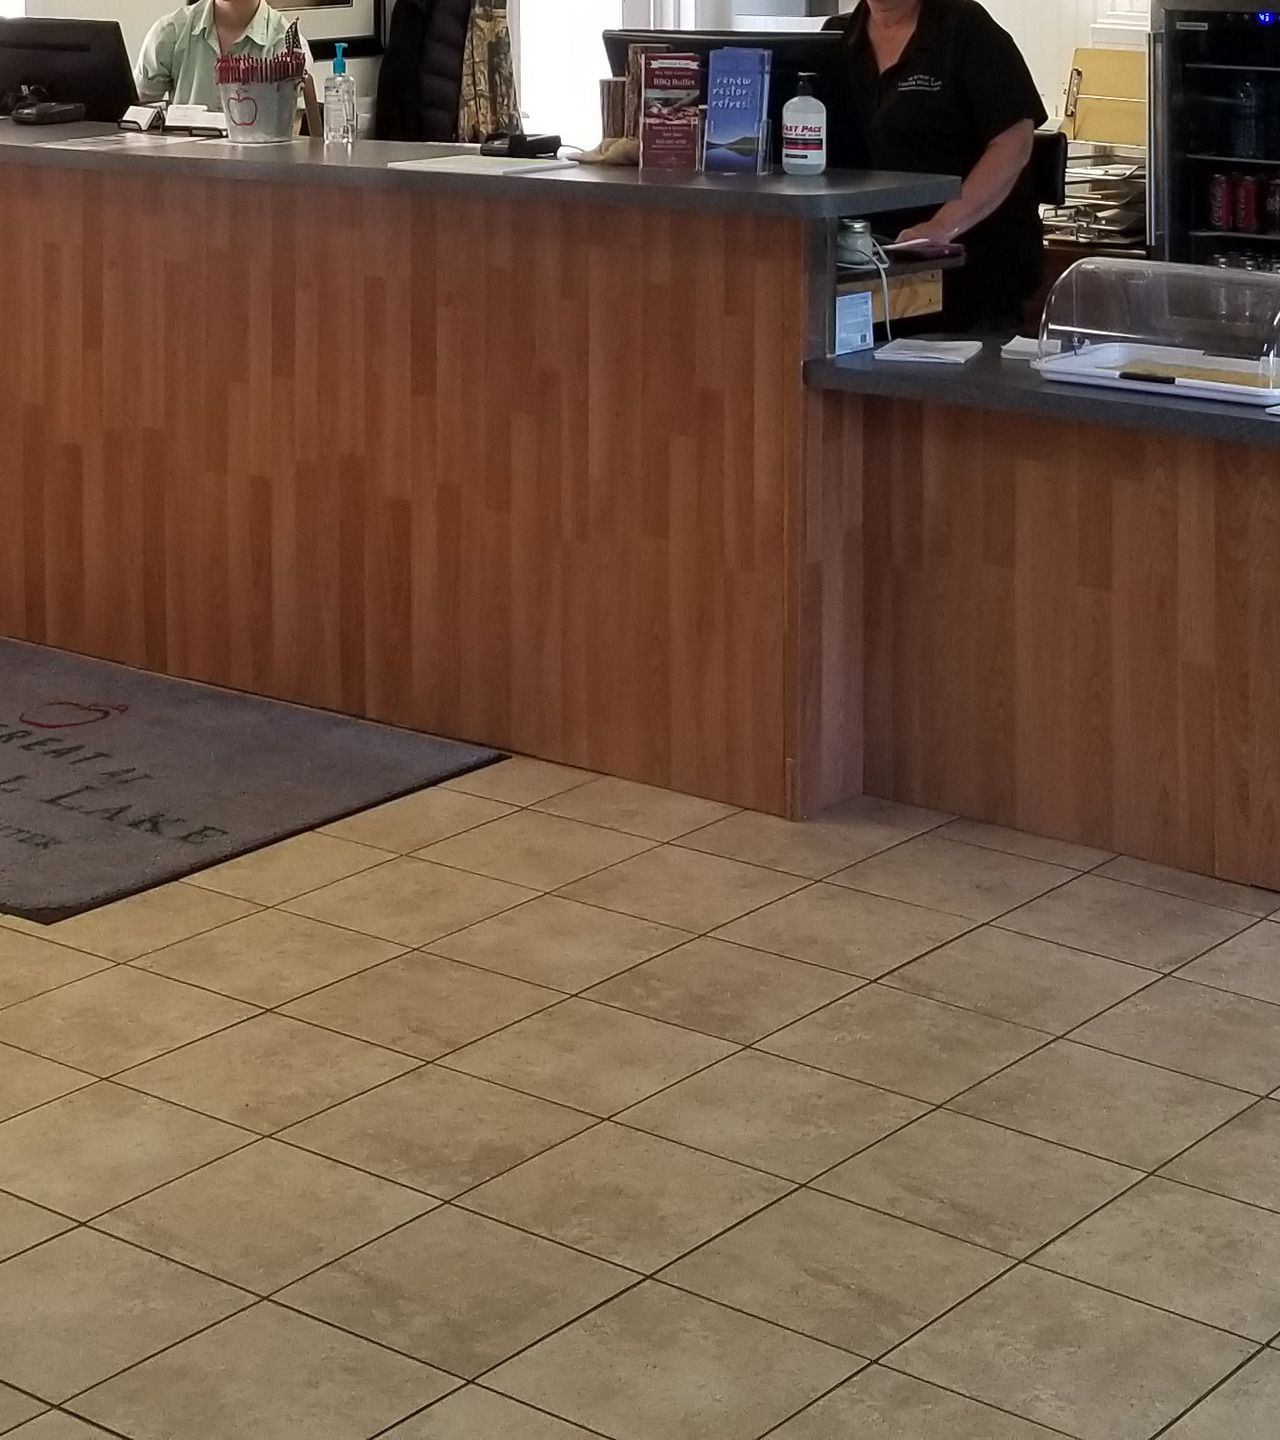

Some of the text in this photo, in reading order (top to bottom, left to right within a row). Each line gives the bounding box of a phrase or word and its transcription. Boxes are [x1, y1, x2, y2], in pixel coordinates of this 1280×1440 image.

[653, 78, 671, 86] BBQ
[716, 77, 752, 85] renew
[783, 125, 799, 133] AST
[40, 783, 231, 846] LAKE
